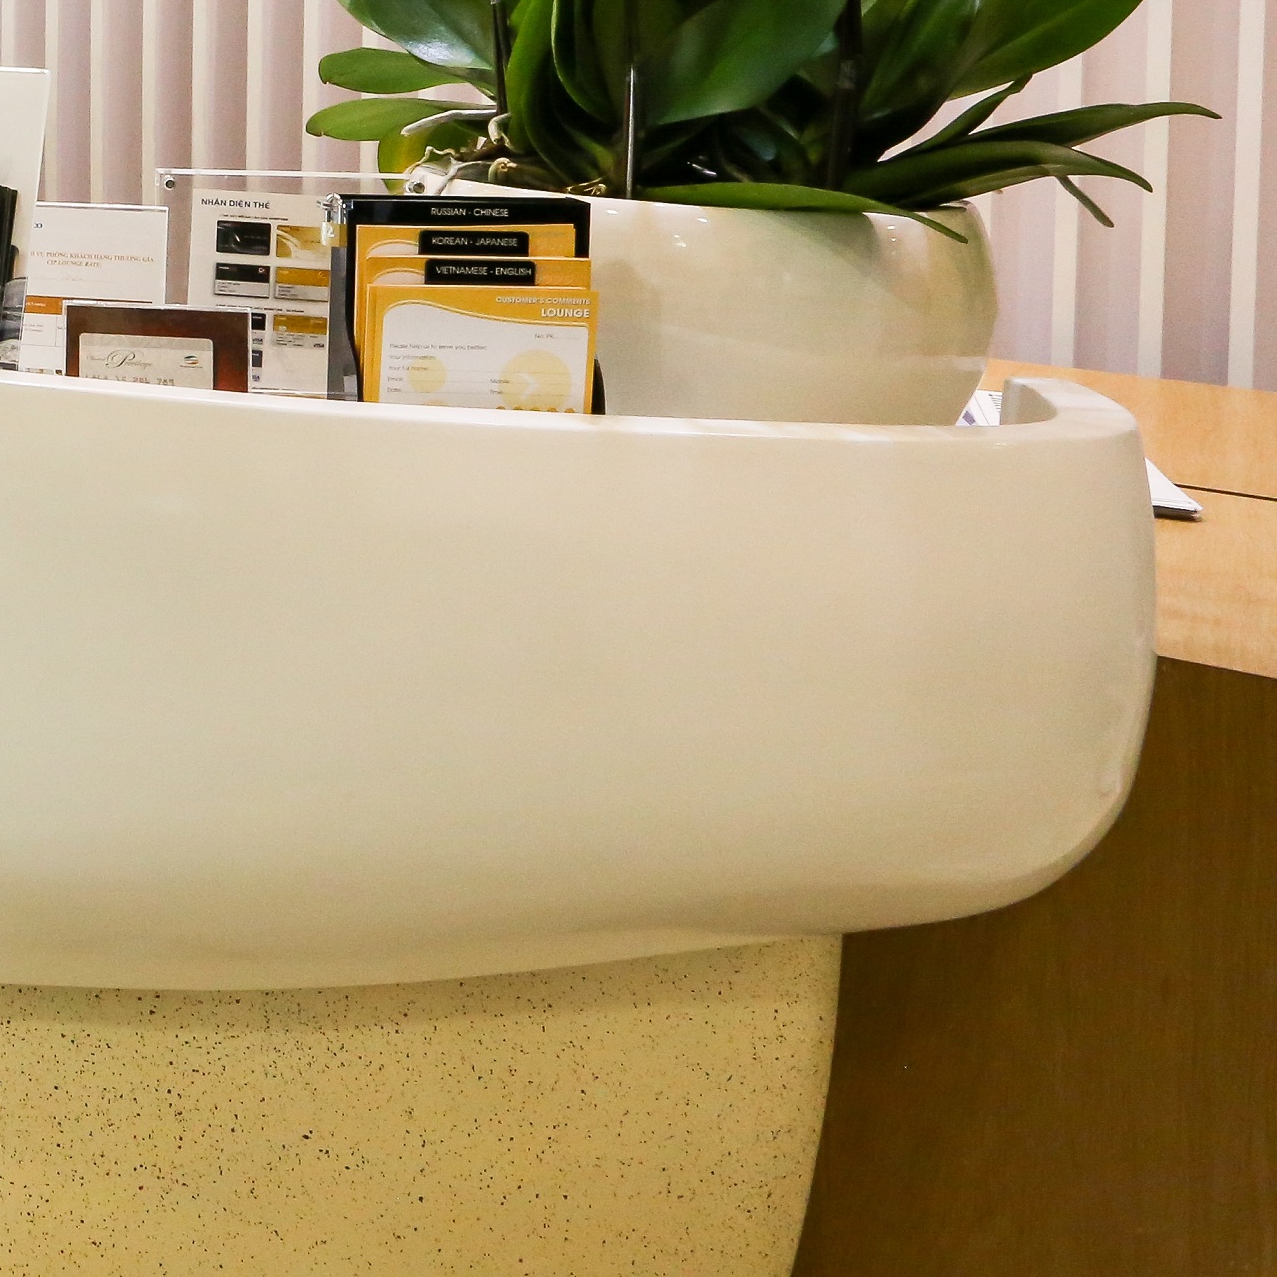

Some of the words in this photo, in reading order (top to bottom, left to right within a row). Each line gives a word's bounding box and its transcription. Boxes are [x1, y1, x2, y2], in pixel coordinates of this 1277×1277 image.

[430, 207, 466, 217] RUSSIAN
[473, 208, 509, 217] CHINESE
[432, 236, 468, 246] KOREAN
[475, 237, 518, 247] JAPANESE
[436, 266, 488, 275] VIETNAMESE
[495, 267, 532, 276] ENGLISH
[545, 297, 591, 305] COMMENTS
[541, 308, 590, 318] LOUNGE
